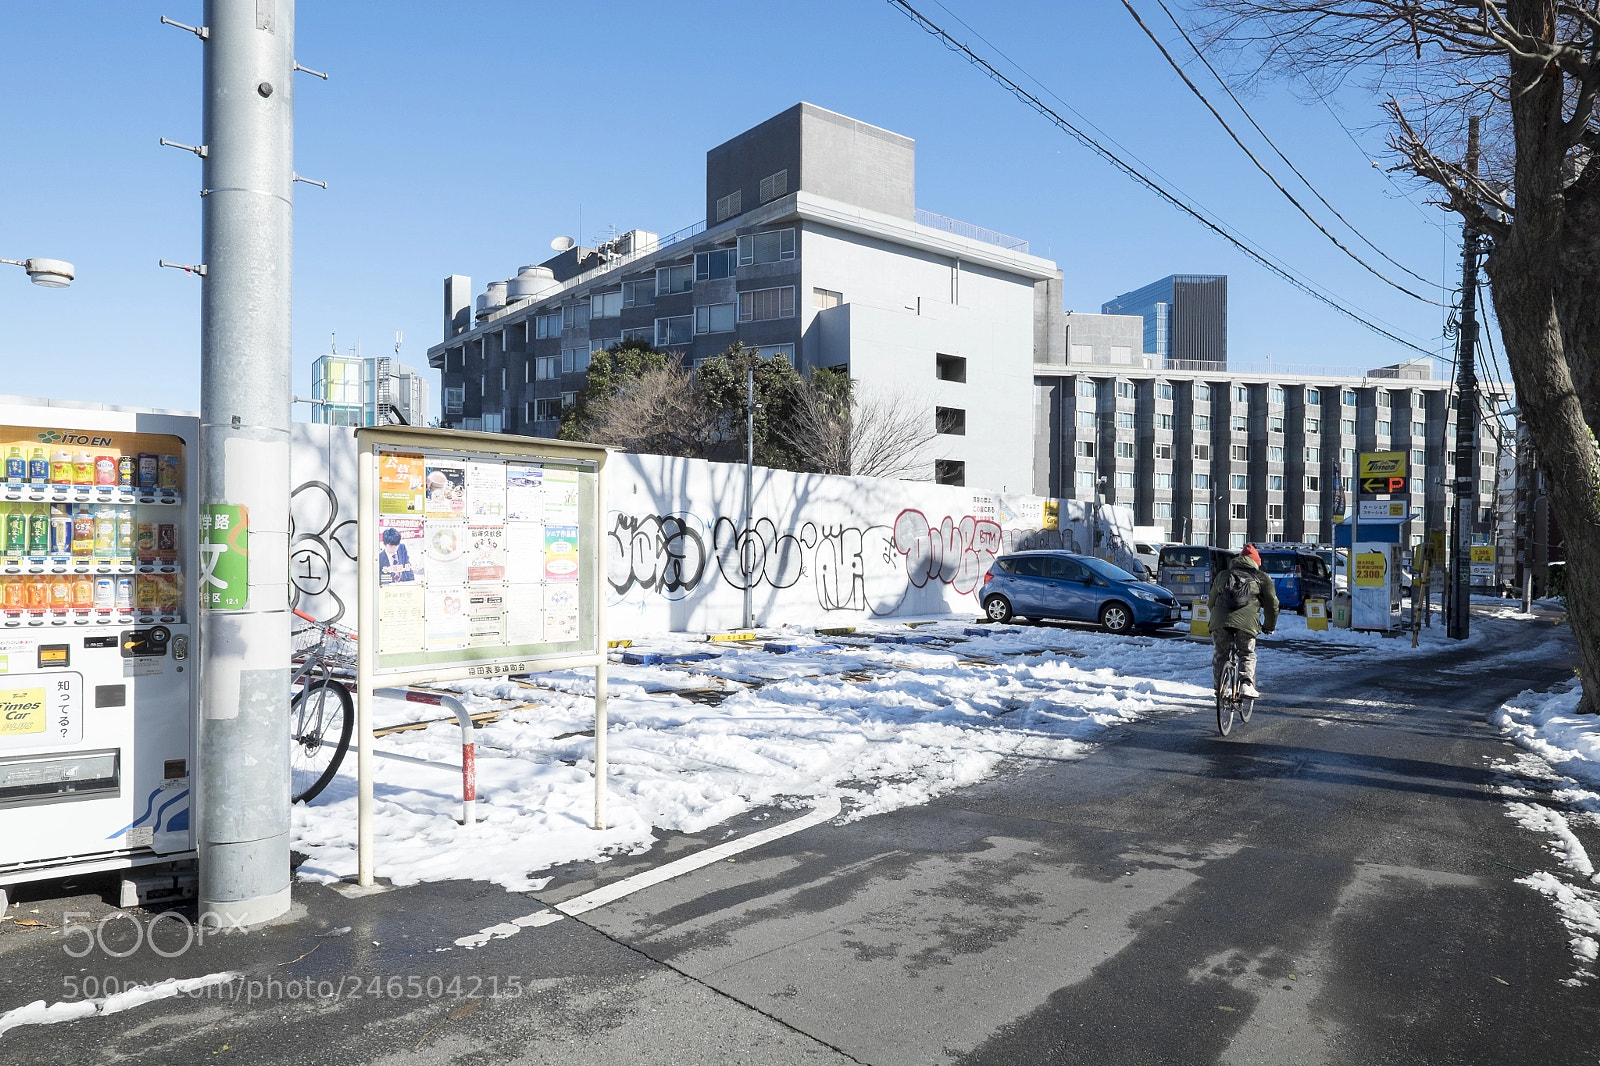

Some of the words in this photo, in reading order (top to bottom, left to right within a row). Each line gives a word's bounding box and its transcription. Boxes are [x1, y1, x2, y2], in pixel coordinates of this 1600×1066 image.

[61, 434, 89, 444] ITO
[90, 437, 112, 447] EN
[1367, 460, 1399, 471] Times
[1388, 477, 1404, 493] P
[199, 514, 230, 530] 学路
[979, 530, 996, 547] BTM
[199, 536, 229, 590] 文
[199, 592, 221, 603] 谷区
[5, 711, 31, 721] Car
[2, 721, 34, 732] PLUS
